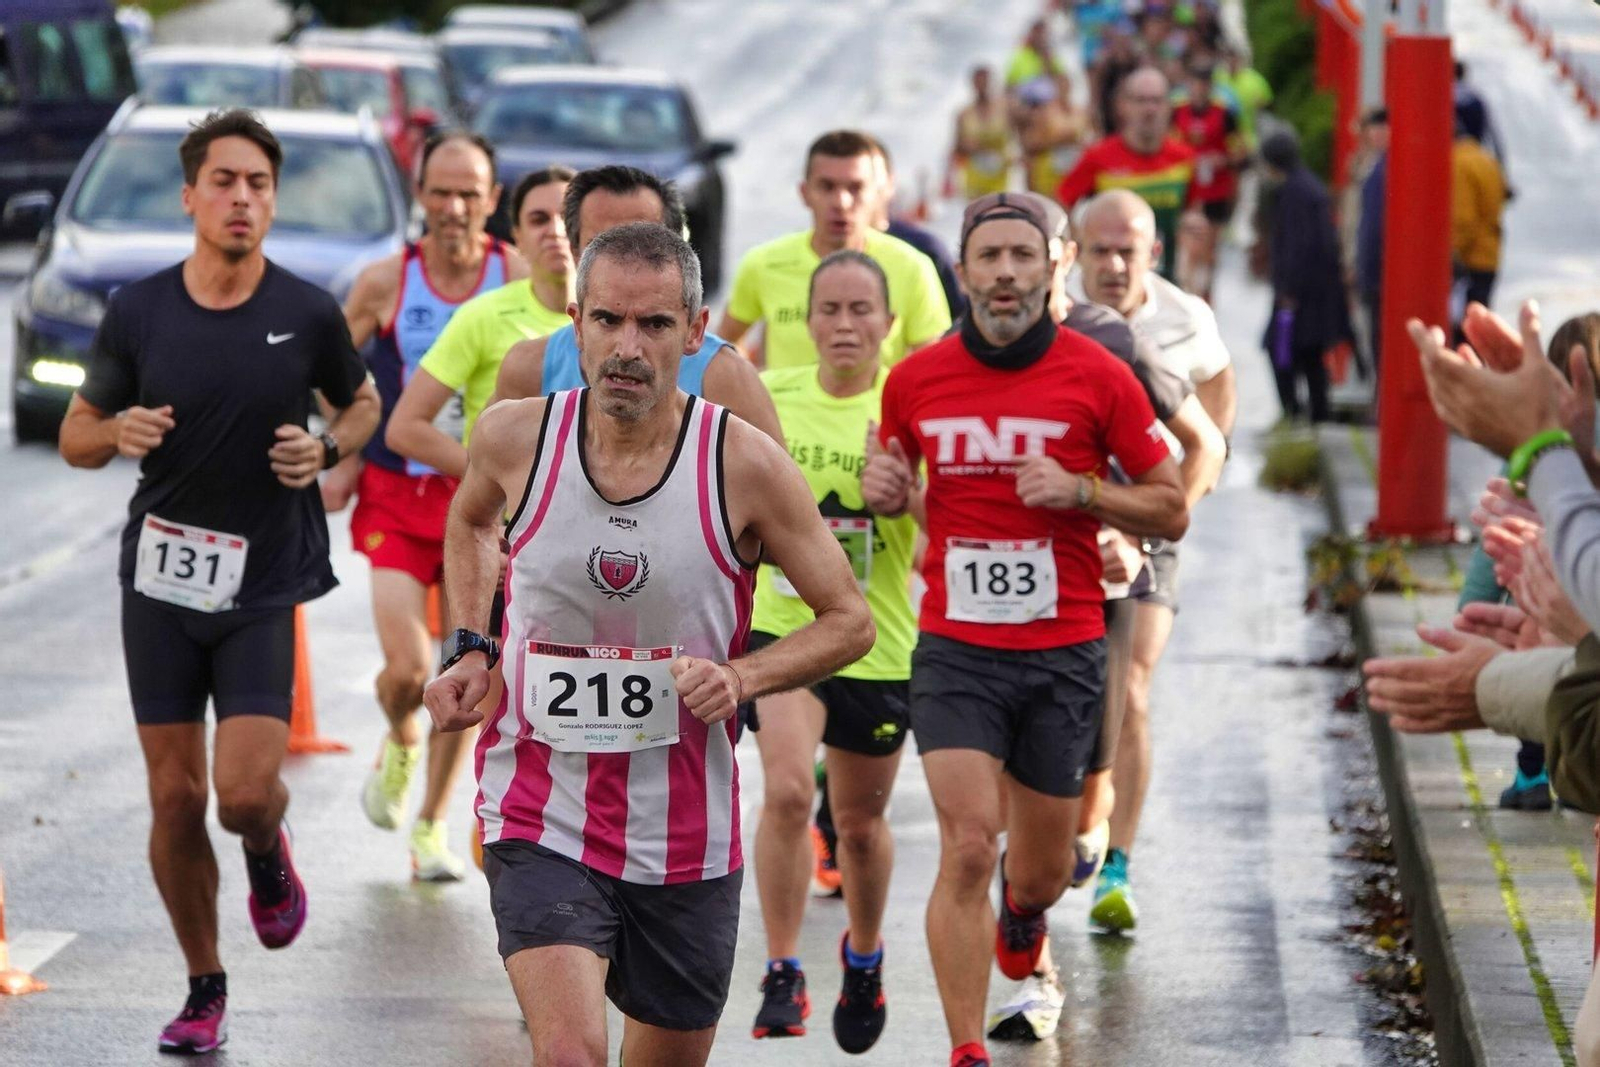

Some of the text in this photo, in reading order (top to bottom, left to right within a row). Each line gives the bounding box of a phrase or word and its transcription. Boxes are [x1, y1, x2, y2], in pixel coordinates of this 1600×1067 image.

[918, 415, 1071, 465] TNT
[938, 465, 996, 476] ENERGY
[608, 515, 638, 528] AMURA
[156, 542, 220, 585] 131
[965, 562, 1036, 595] 183
[547, 671, 654, 719] 218
